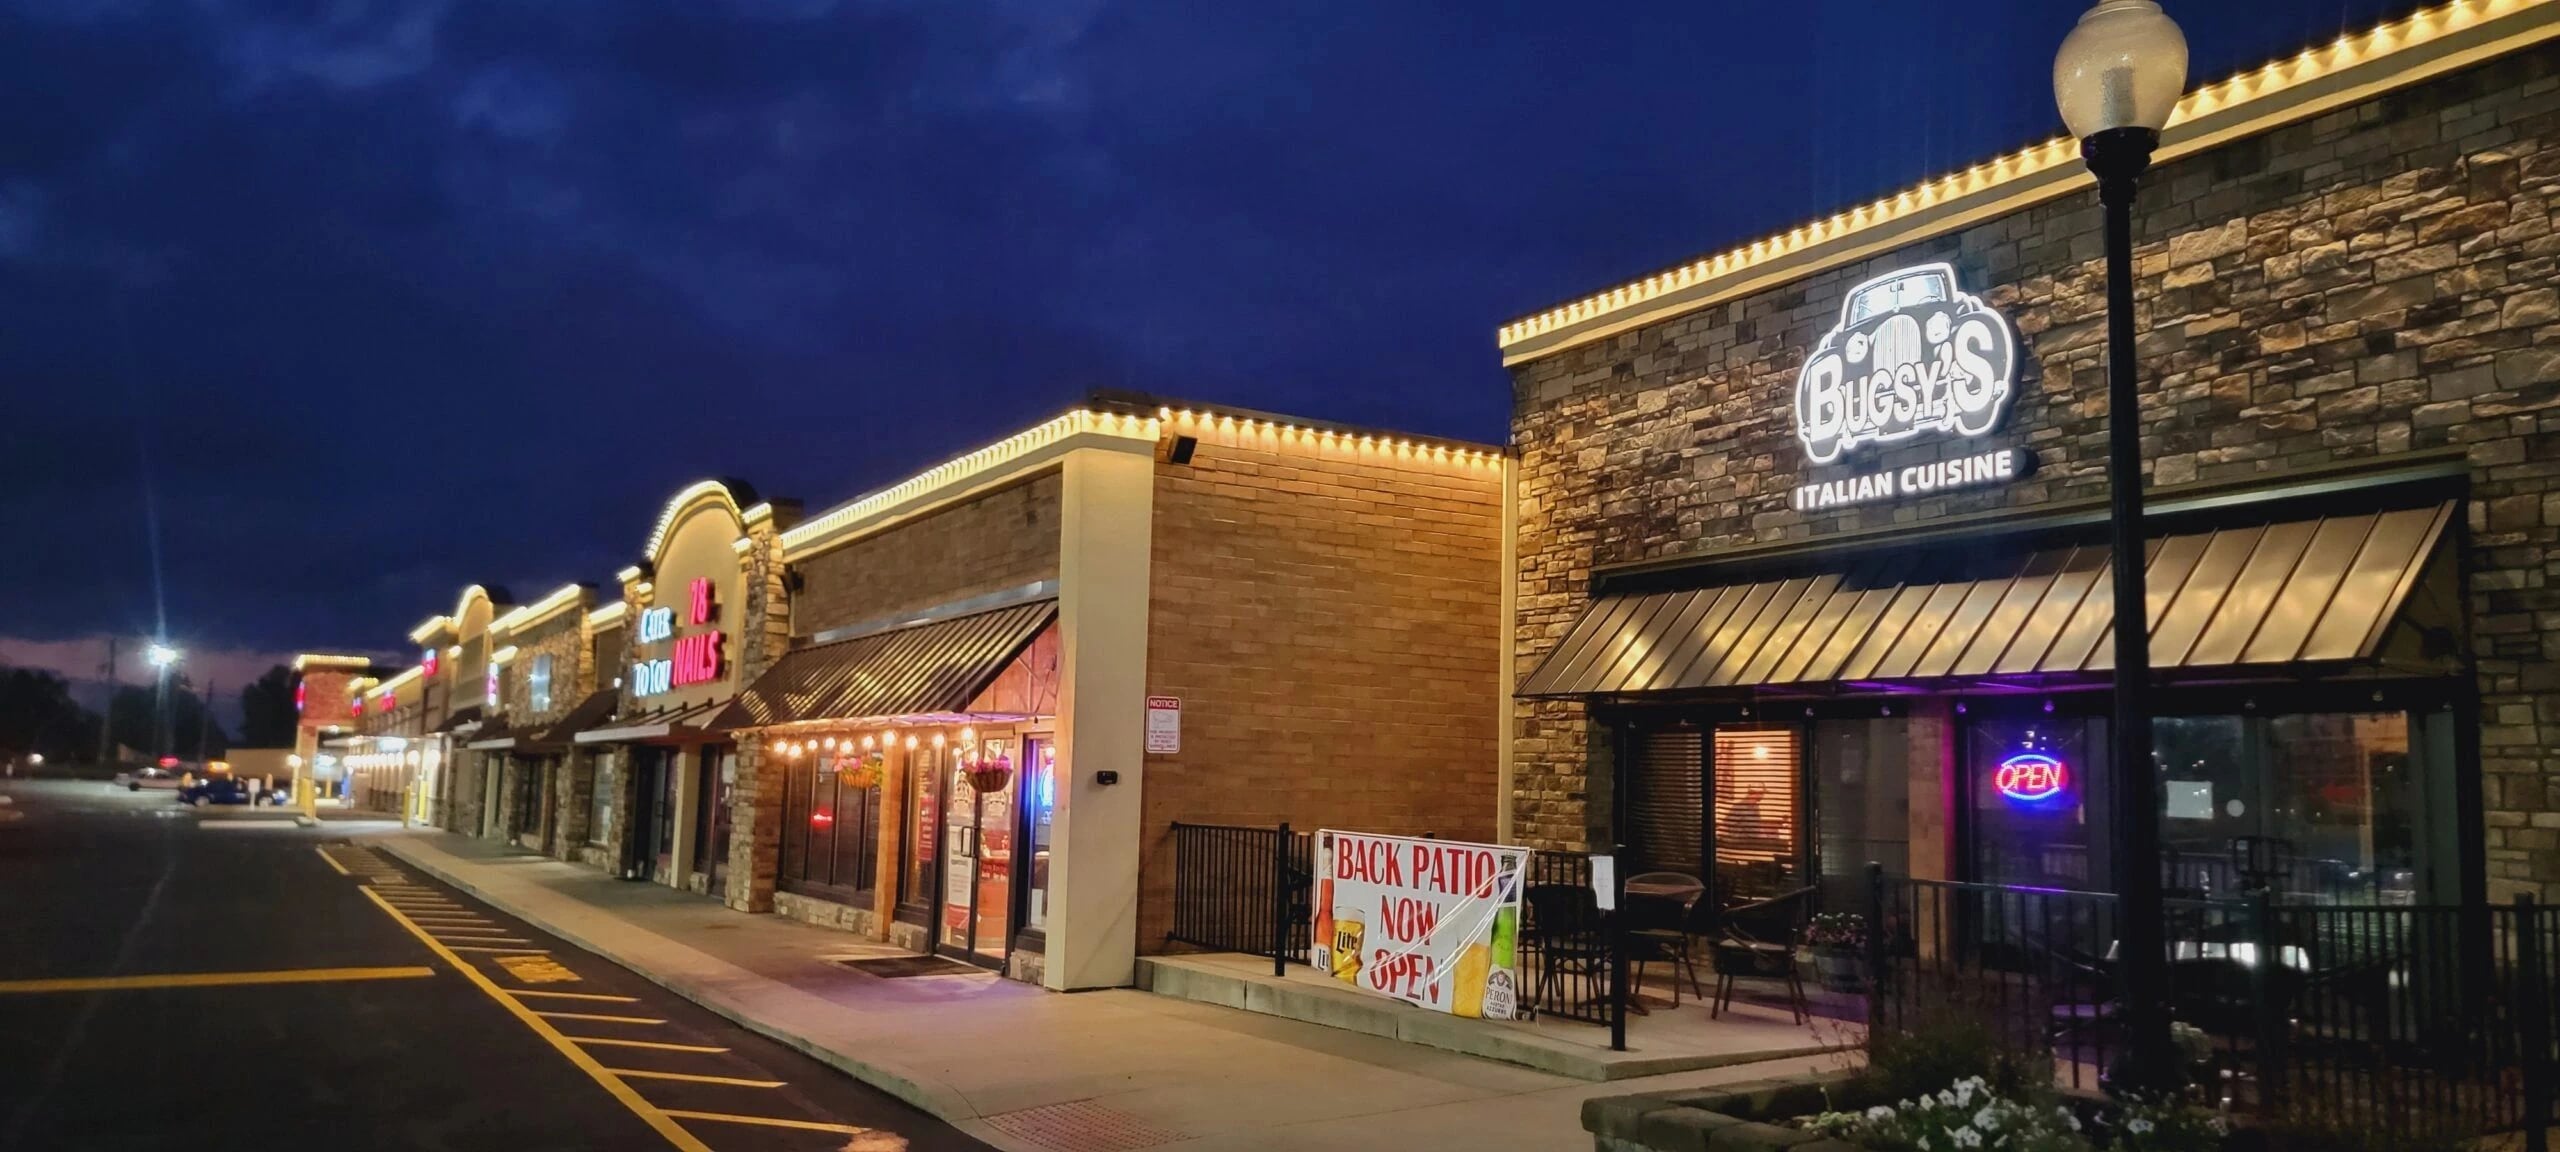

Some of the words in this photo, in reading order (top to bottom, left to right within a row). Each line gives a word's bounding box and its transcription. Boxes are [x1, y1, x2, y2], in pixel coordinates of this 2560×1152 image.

[1809, 319, 1995, 443] BUGSY'S
[1796, 470, 1893, 509] ITALIAN
[1900, 449, 2013, 493] CUISINE
[640, 606, 671, 643] CATER
[673, 630, 719, 686] NAILS
[1149, 699, 1178, 709] NOTICE
[1995, 761, 2063, 790] OPEN
[1337, 836, 1403, 887] BACK
[1412, 844, 1496, 899] PATIO
[1336, 930, 1358, 954] Lite
[1380, 894, 1441, 946] NOW
[1369, 948, 1445, 1005] OPEN
